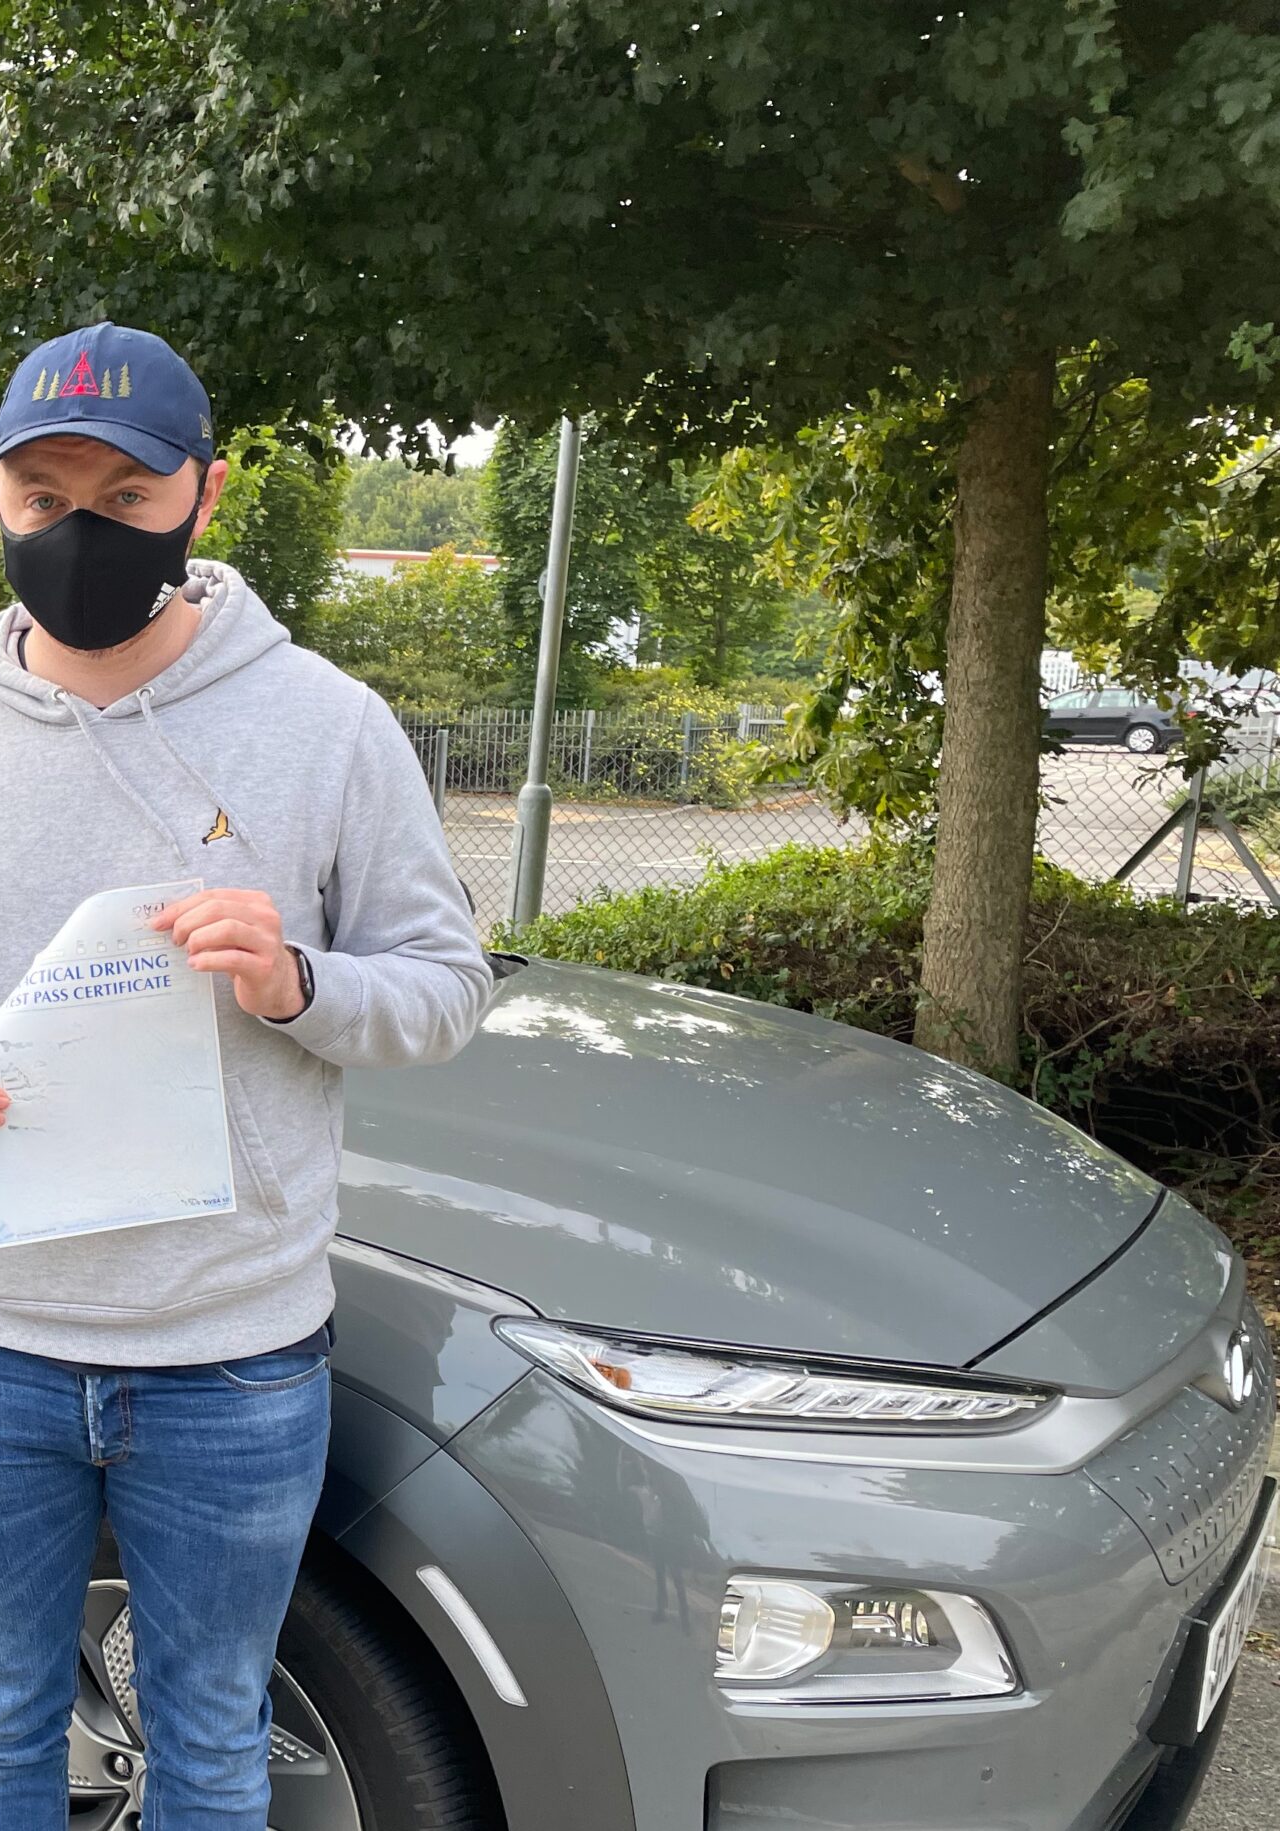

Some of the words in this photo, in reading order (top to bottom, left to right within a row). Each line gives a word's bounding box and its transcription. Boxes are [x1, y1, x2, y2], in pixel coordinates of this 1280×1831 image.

[90, 953, 169, 979] DRIVING
[34, 988, 69, 1004] PASS
[73, 974, 172, 999] CERTIFICATE
